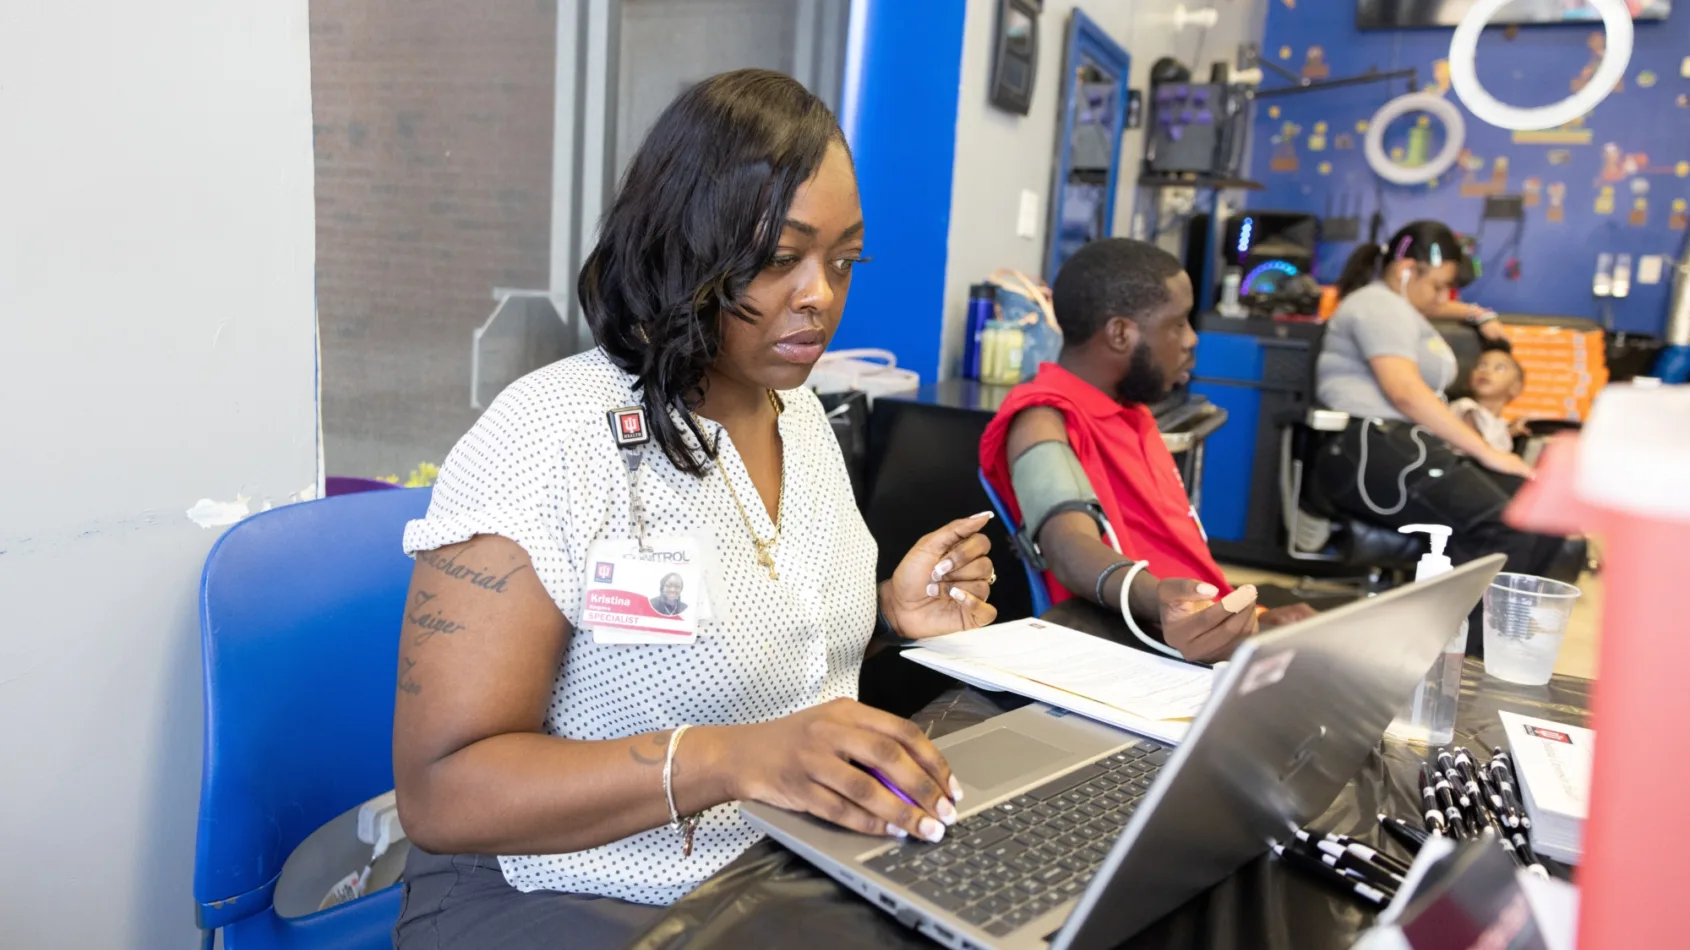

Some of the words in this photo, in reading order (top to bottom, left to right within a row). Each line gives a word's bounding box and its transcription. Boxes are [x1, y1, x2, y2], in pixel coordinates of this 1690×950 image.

[417, 543, 528, 593] achariah
[590, 593, 631, 606] Kristina
[588, 612, 639, 624] SPECIALIST
